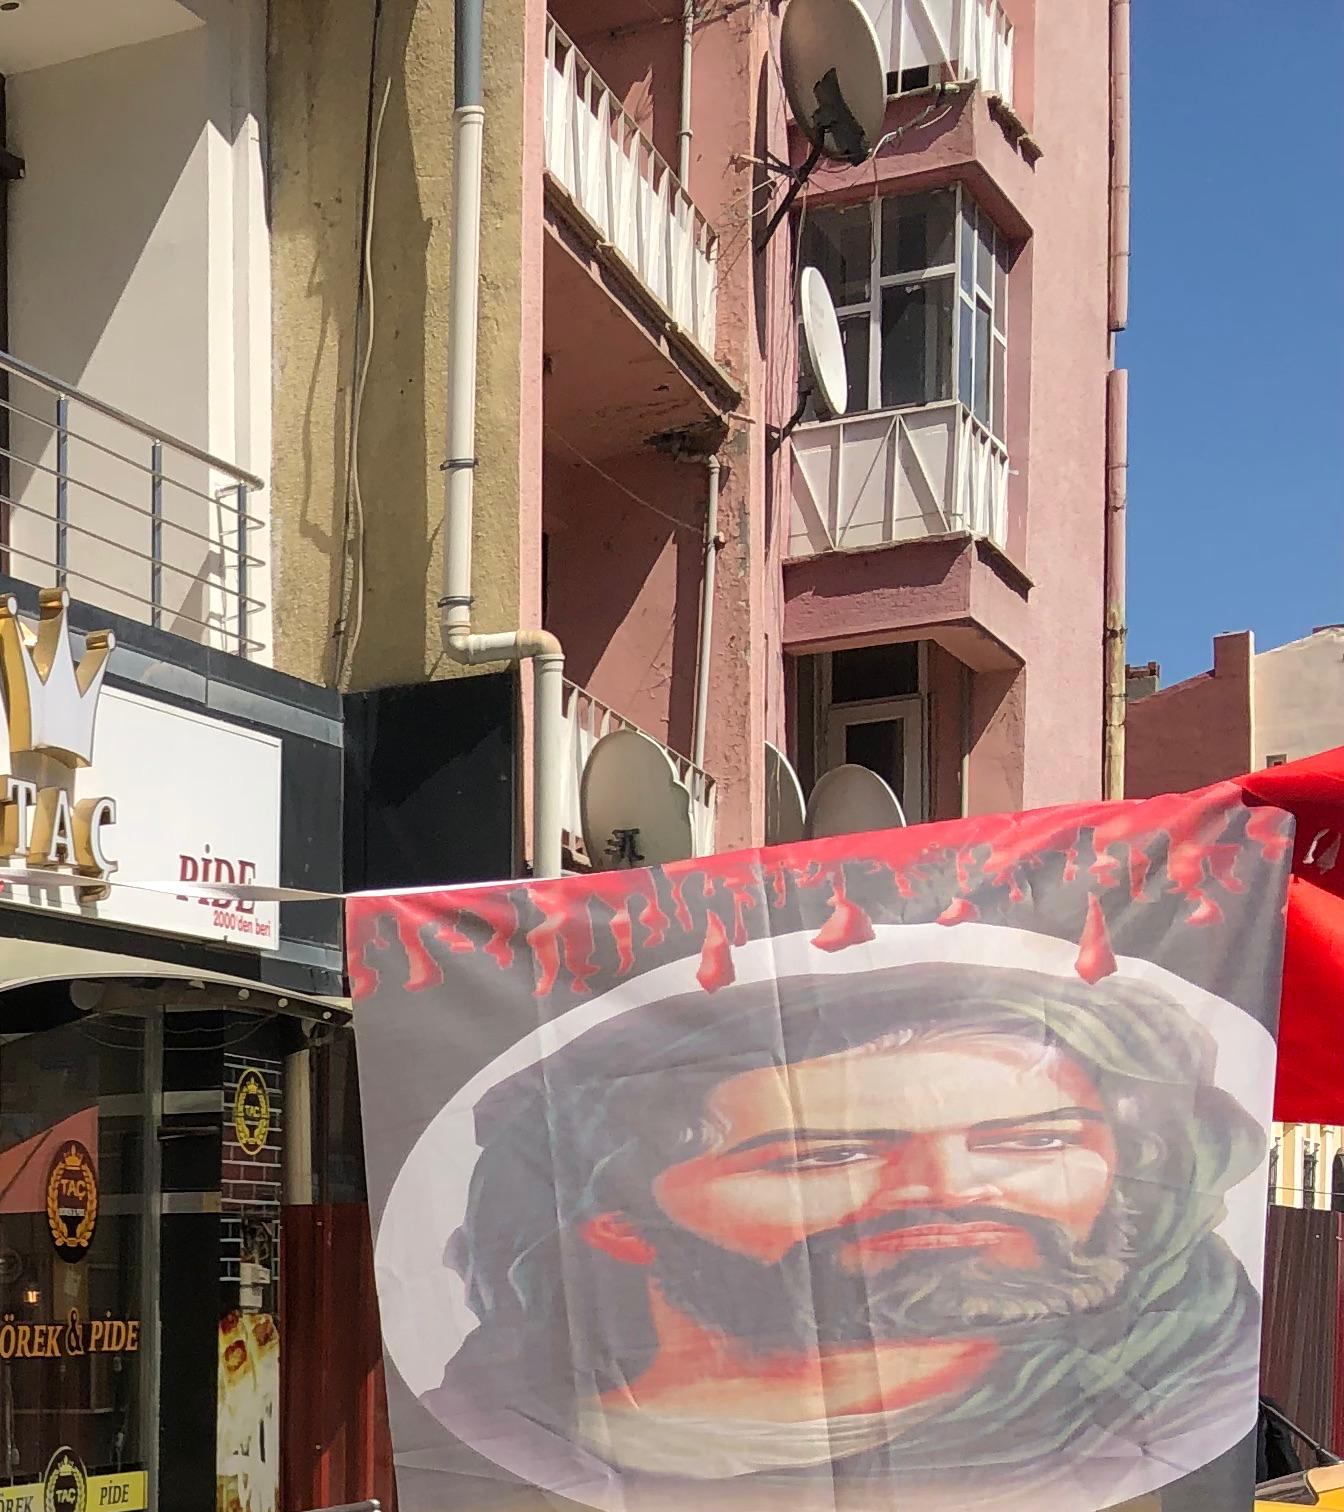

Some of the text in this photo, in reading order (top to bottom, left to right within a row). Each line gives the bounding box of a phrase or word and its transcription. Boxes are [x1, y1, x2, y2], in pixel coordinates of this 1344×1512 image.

[2, 776, 117, 888] TAÇ
[176, 843, 256, 915] PİDE
[60, 1178, 87, 1201] TAÇ
[0, 1313, 62, 1359] ÖREK
[88, 1309, 140, 1352] PİDE
[55, 1488, 76, 1504] TAÇ
[99, 1480, 129, 1506] PİDE
